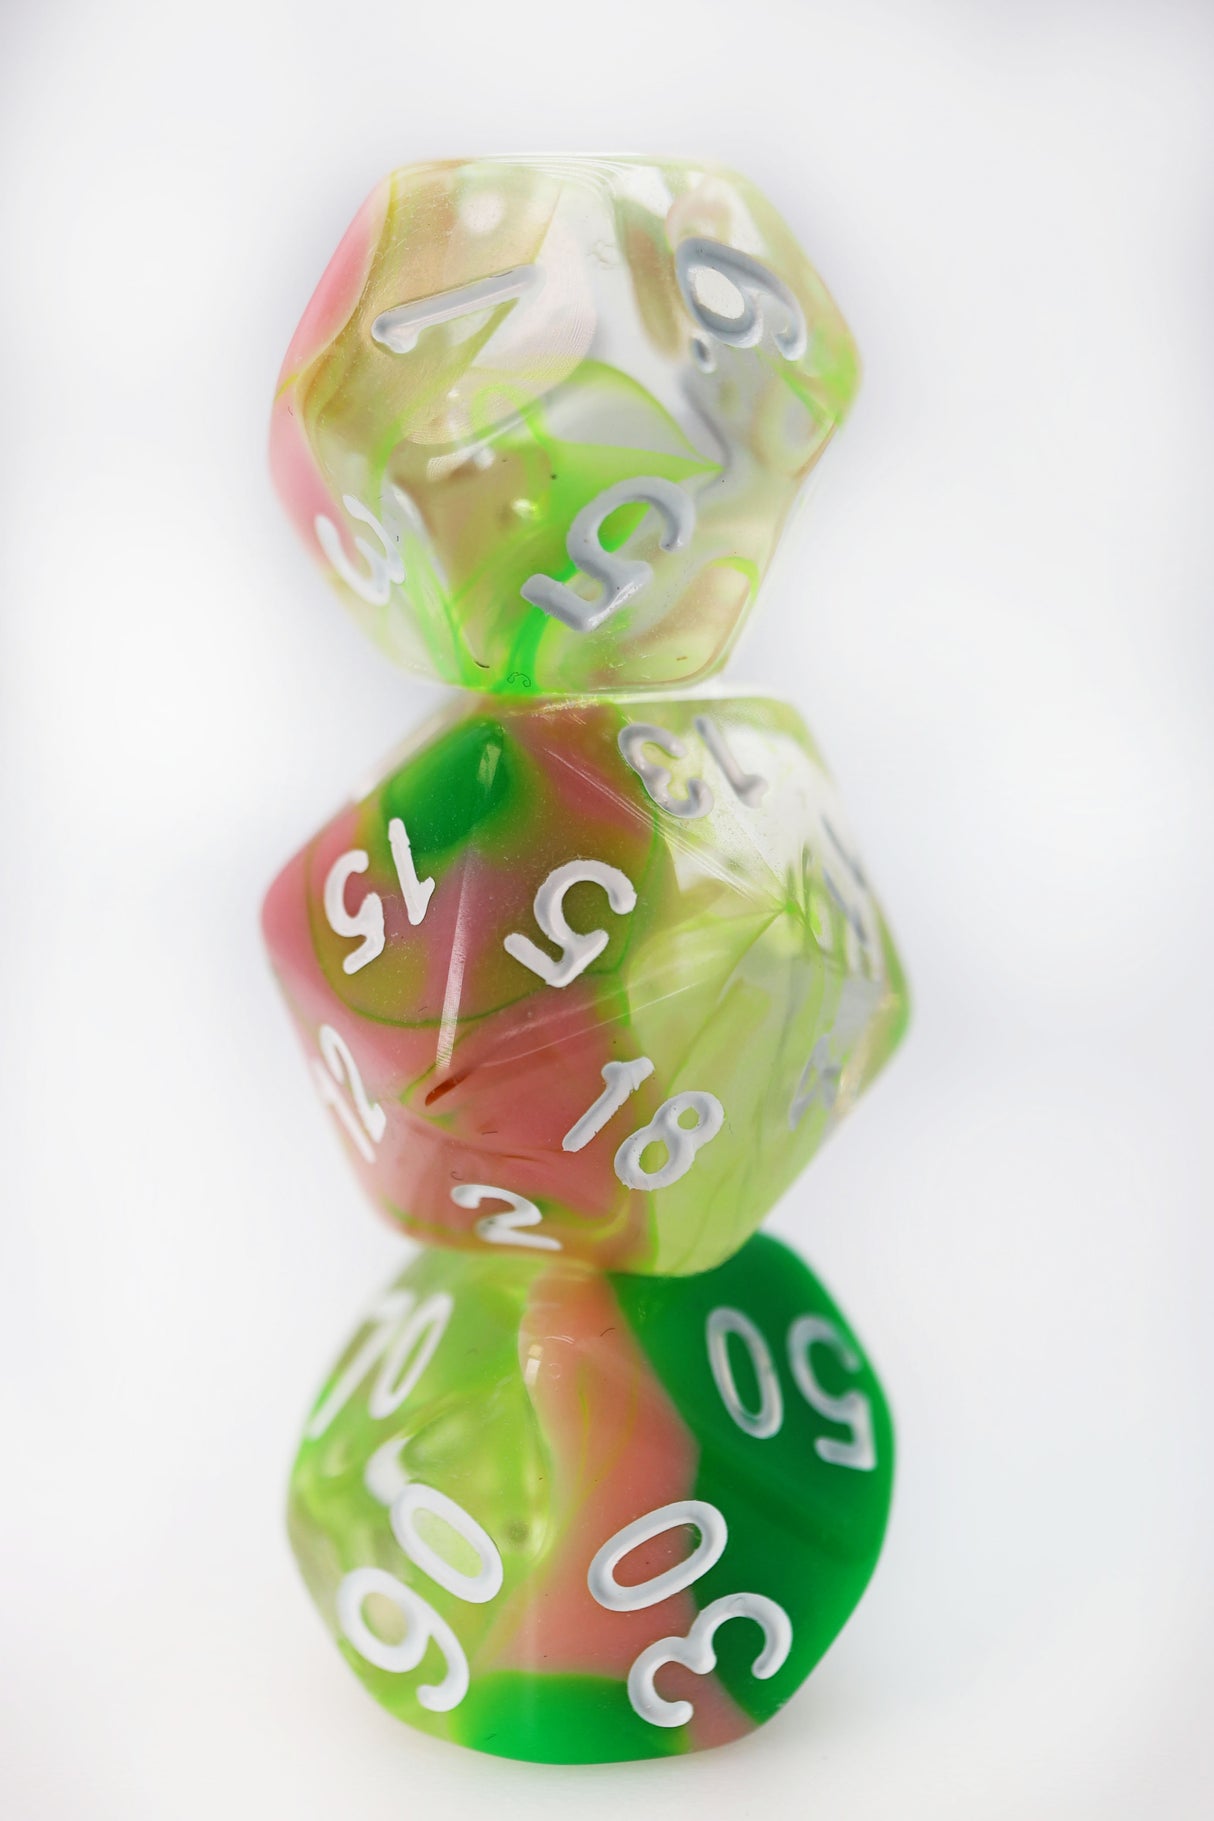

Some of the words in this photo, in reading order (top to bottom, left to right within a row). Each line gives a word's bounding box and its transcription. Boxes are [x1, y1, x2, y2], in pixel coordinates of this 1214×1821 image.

[371, 264, 543, 353] 1
[520, 476, 695, 632] 5
[618, 716, 768, 819] 13
[324, 818, 436, 974] 15
[503, 859, 637, 987] 5
[311, 1024, 387, 1164] 12
[561, 1056, 724, 1190] 18
[450, 1184, 562, 1250] 2
[706, 1307, 877, 1472] 50
[587, 1500, 793, 1727] 30
